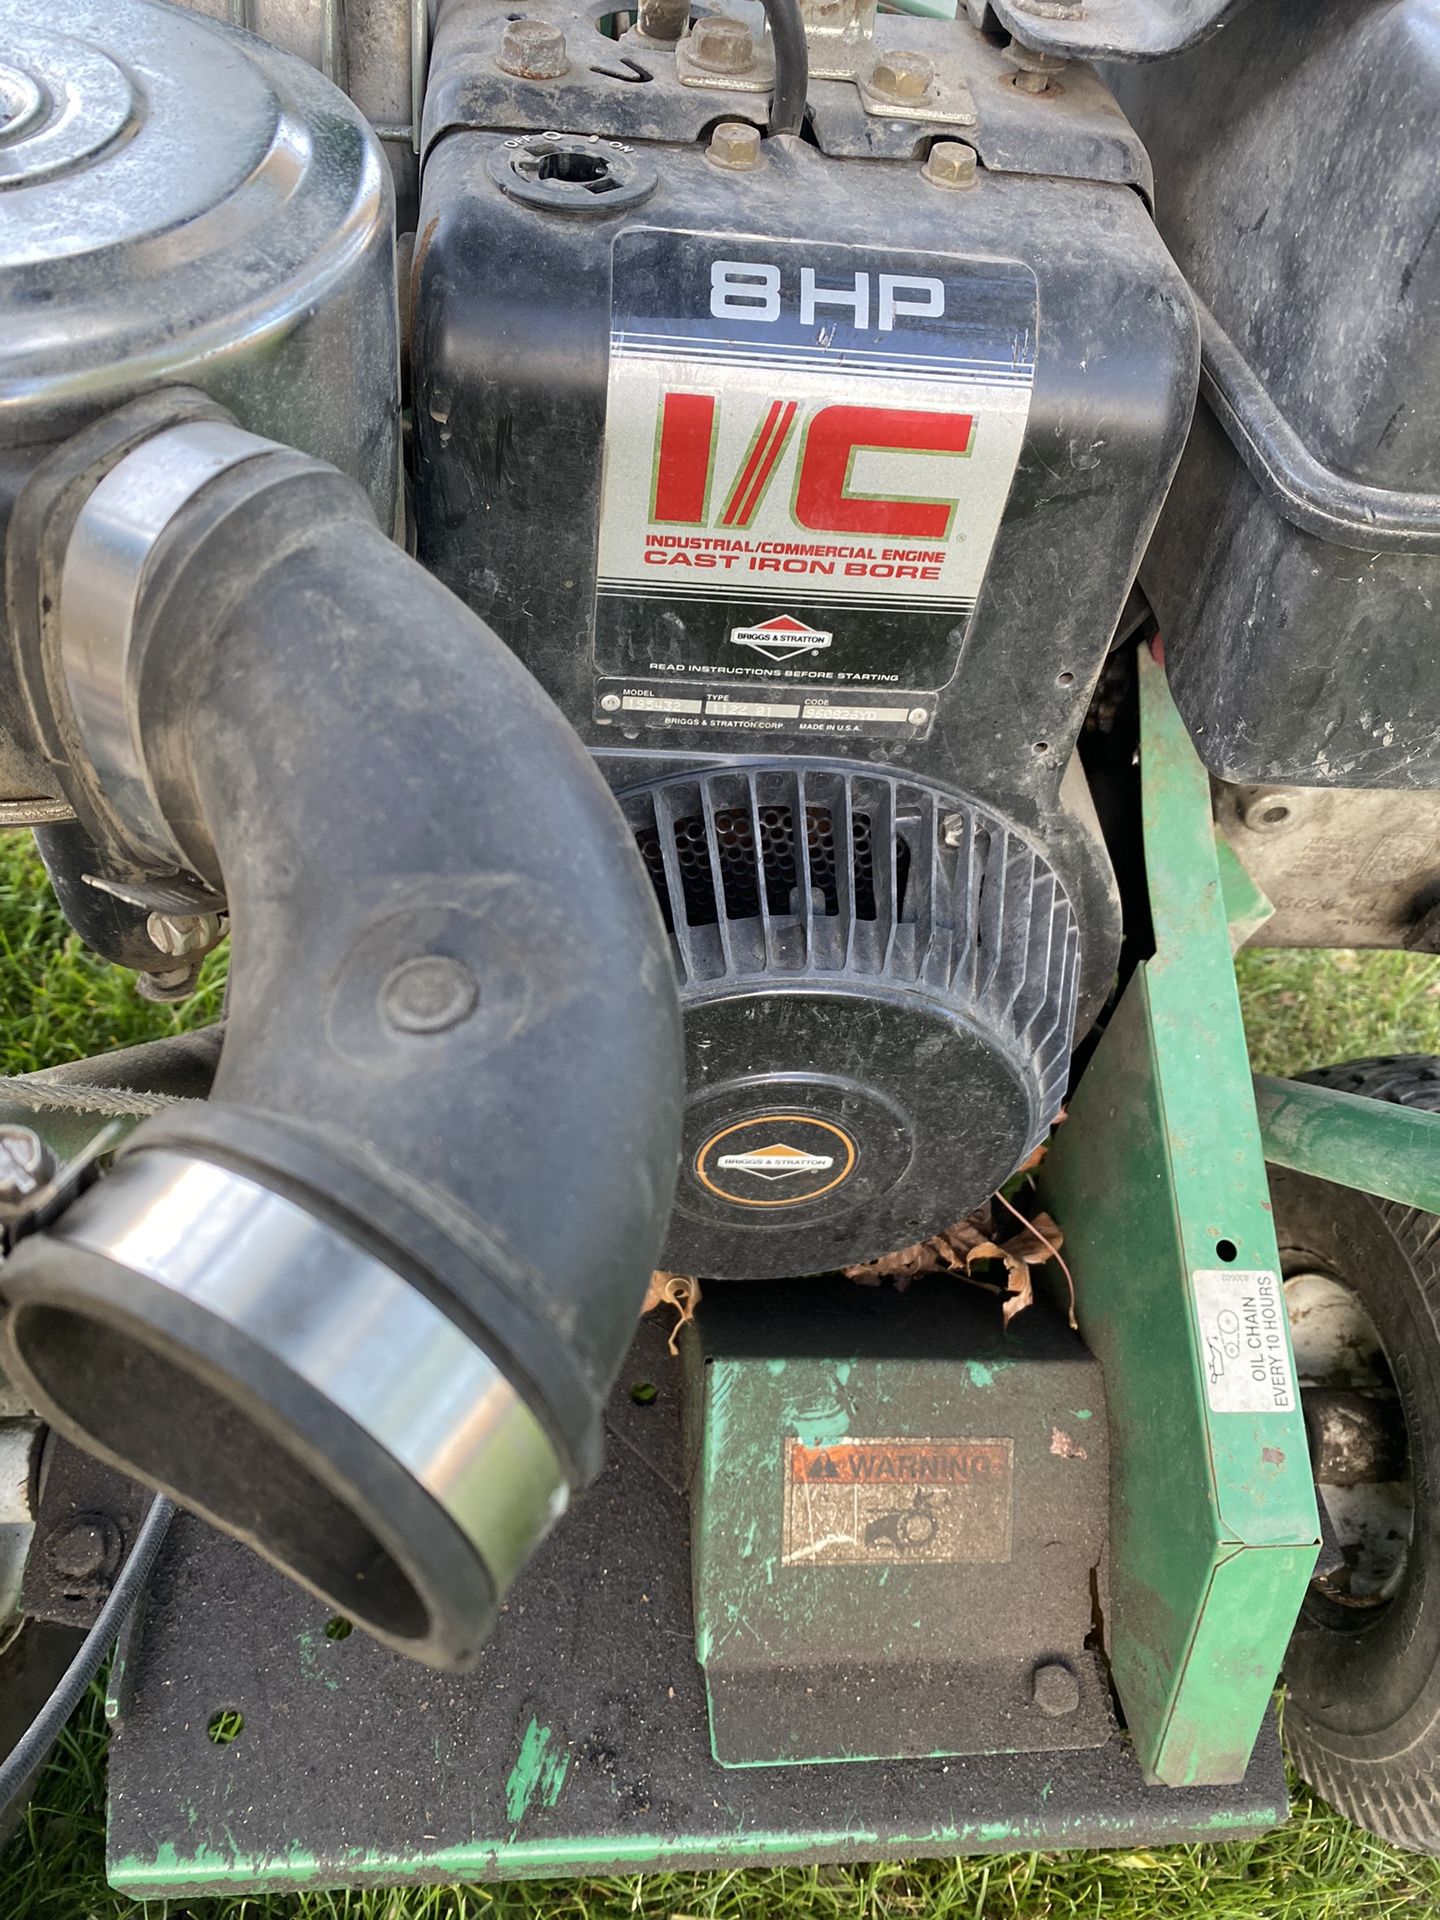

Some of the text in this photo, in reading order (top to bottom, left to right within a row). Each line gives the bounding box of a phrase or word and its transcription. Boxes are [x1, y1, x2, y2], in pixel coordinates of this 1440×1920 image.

[504, 134, 532, 148] OFF
[608, 141, 634, 153] ON
[710, 259, 945, 331] 8 HP
[645, 535, 946, 563] INDUSTRIAL/COMMERCIAL ENGINE
[644, 550, 941, 580] CAST IRON BORE
[737, 632, 825, 643] BRIGGS & STRATTON
[649, 663, 899, 681] READ INSTRUCTIONS BEFORE STARTING
[622, 689, 655, 697] MODEL
[706, 693, 730, 701] TYPE
[628, 698, 682, 714] 195432
[713, 703, 748, 715] 1122
[804, 698, 830, 706] CODE
[664, 717, 699, 726] BRIGGS
[710, 720, 757, 728] STRATTON
[759, 722, 785, 730] CORP.
[799, 723, 825, 731] MADE
[1242, 1297, 1266, 1381] OIL CHAIN
[1257, 1276, 1289, 1407] EVERY 10 HOURS
[848, 1455, 990, 1479] WARNING
